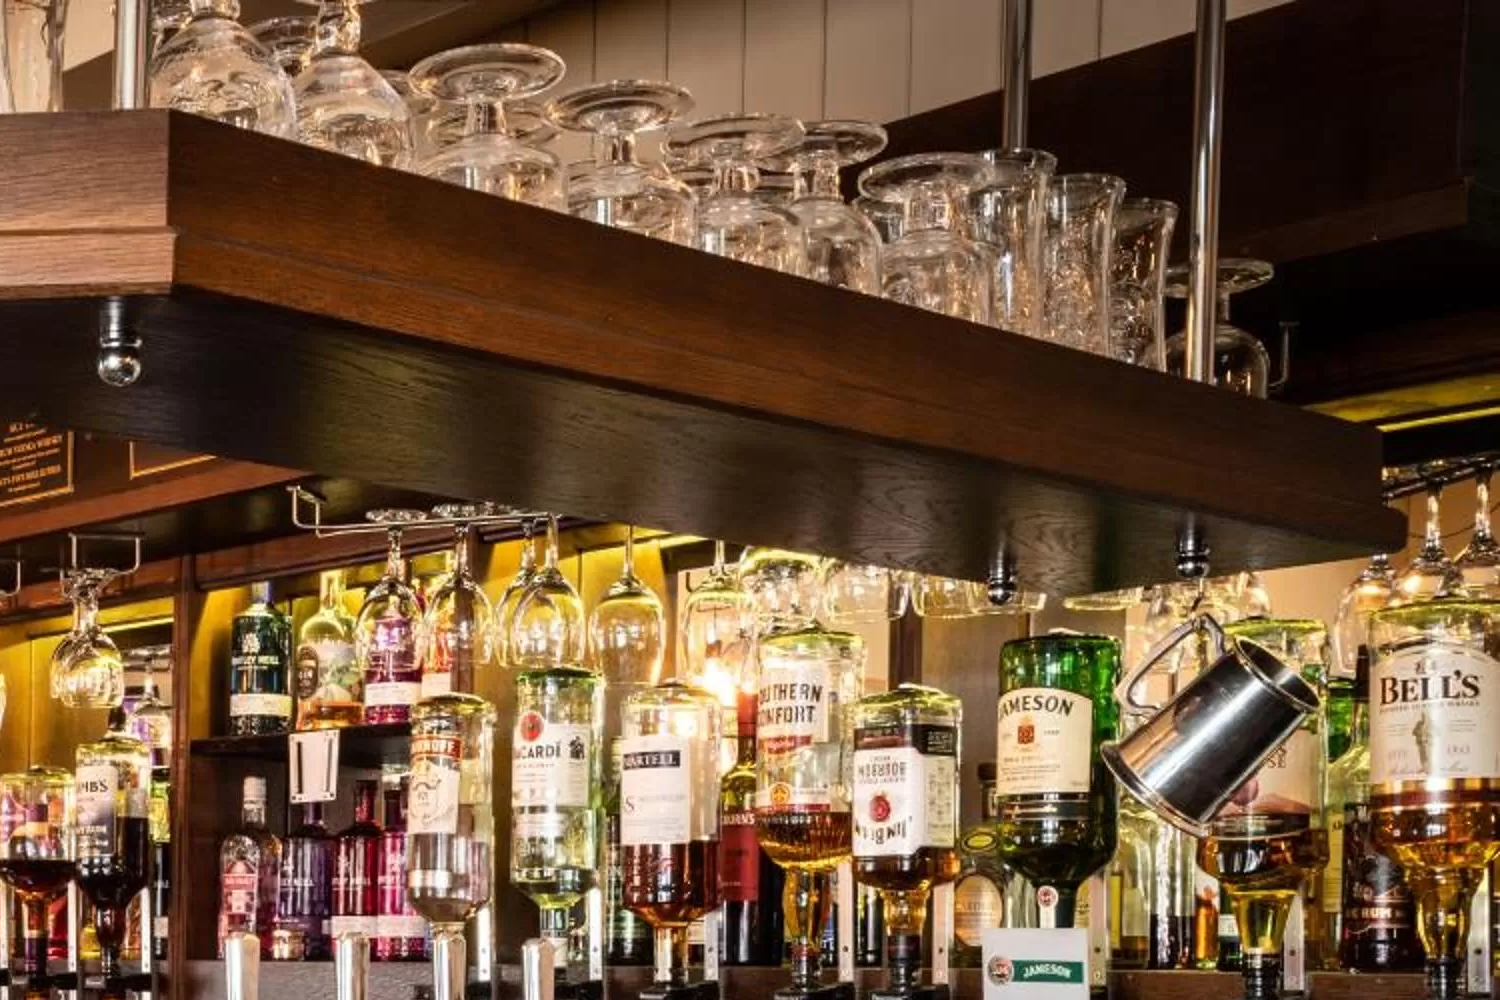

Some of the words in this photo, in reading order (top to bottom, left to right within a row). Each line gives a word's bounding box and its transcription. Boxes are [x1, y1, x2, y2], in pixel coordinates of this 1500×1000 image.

[1380, 669, 1480, 706] BELL'S
[1000, 695, 1074, 721] AMESON
[1023, 963, 1072, 979] JAMESON
